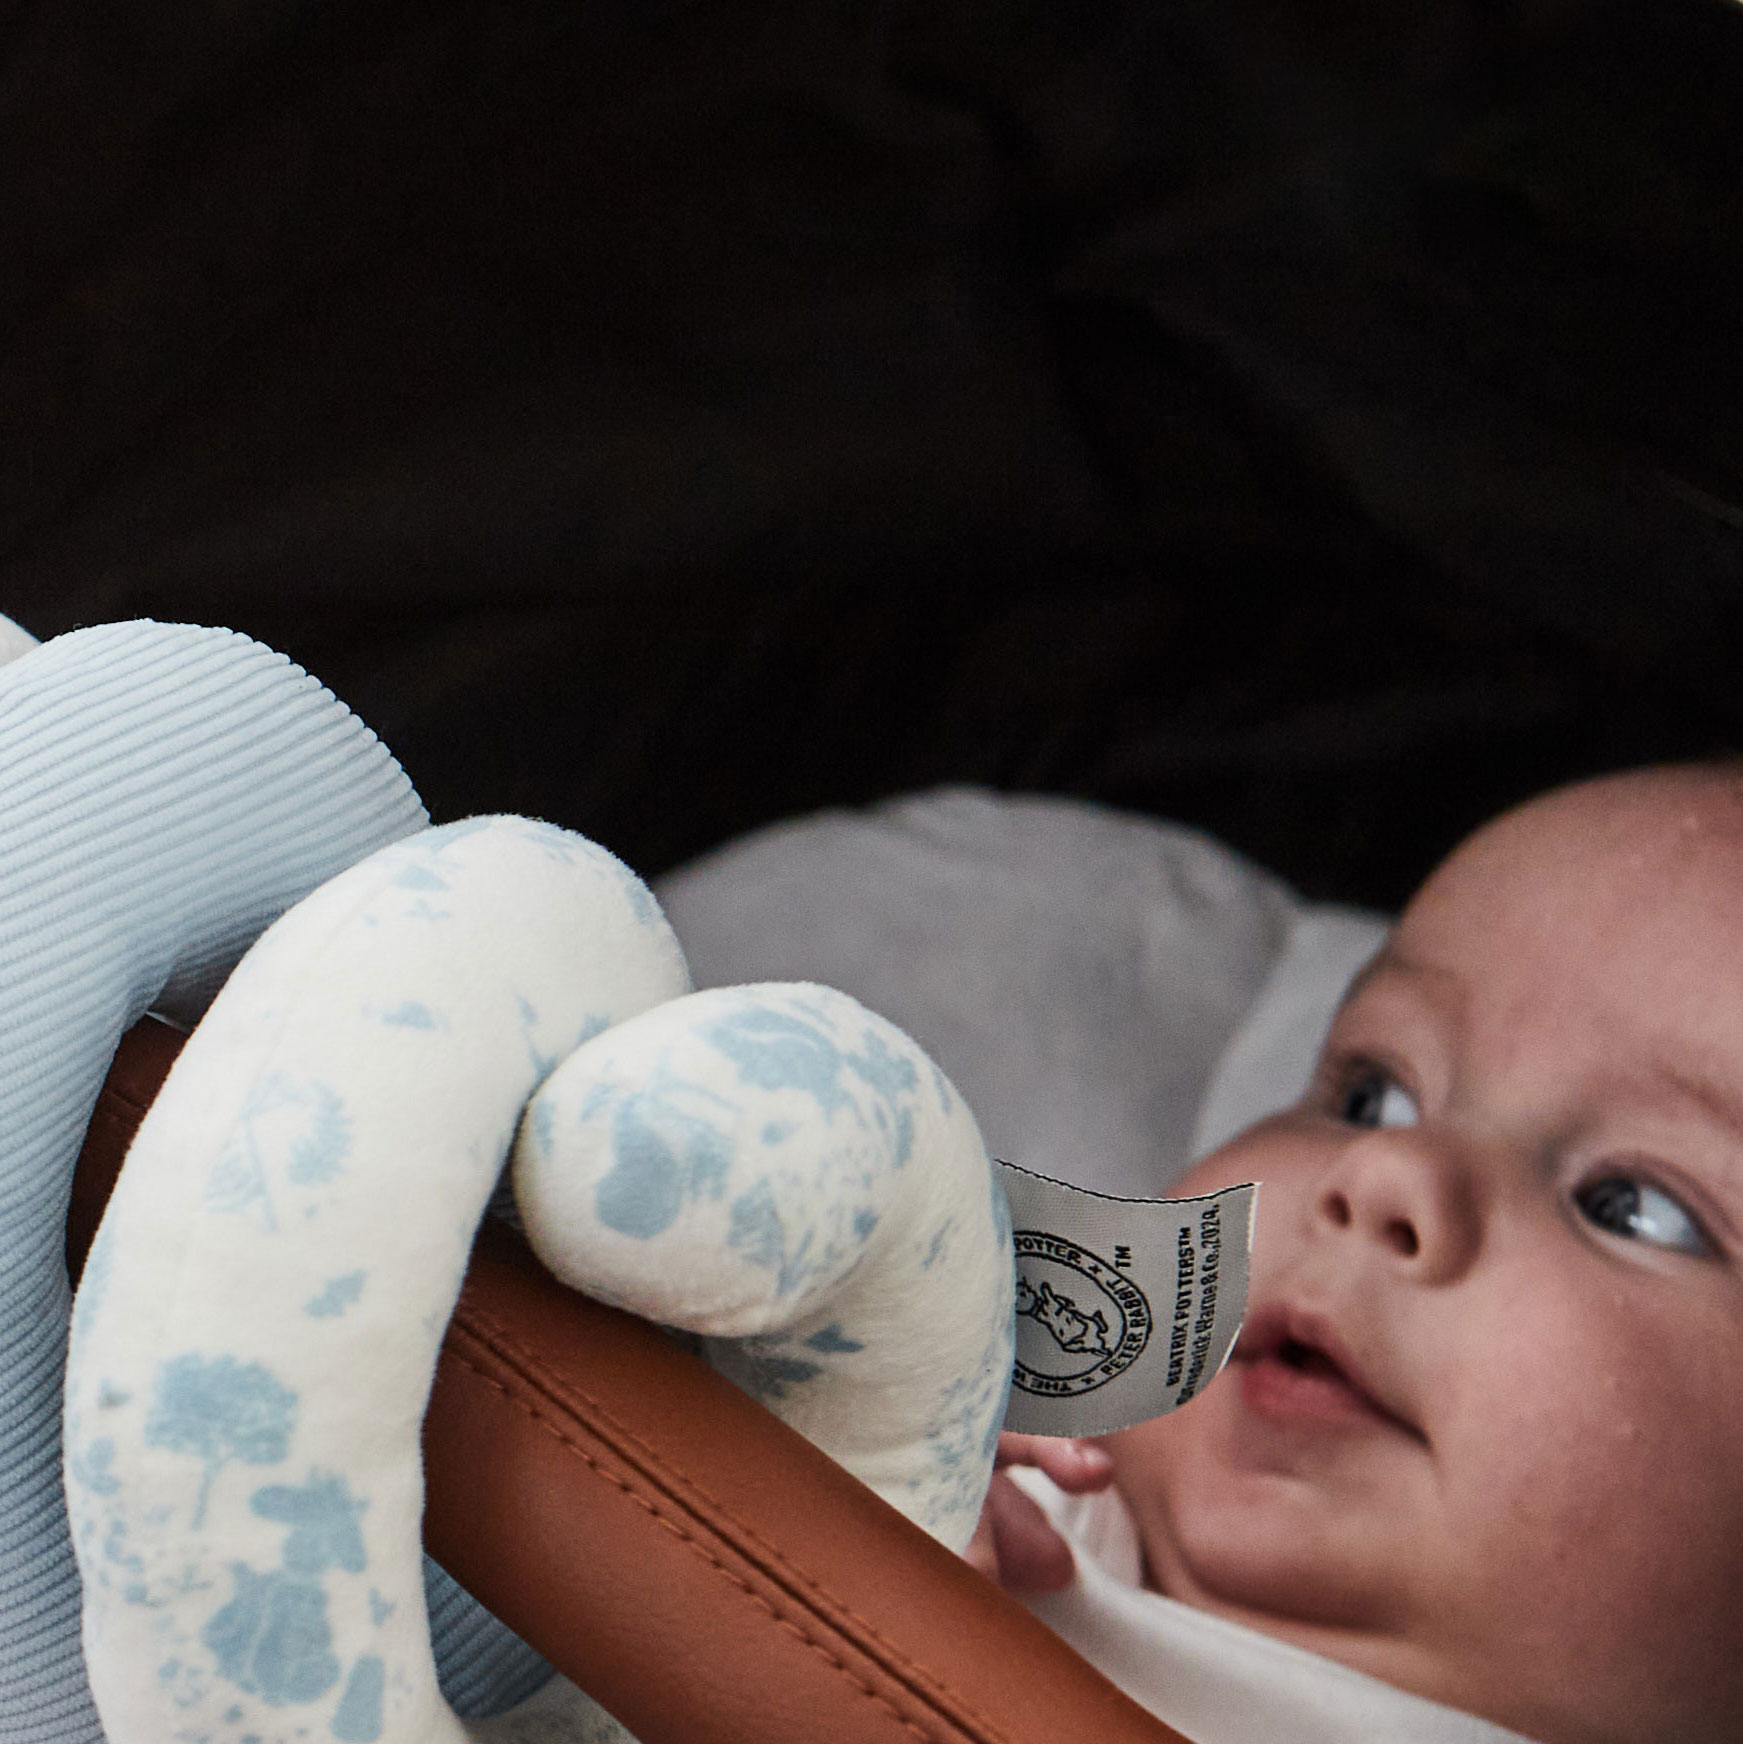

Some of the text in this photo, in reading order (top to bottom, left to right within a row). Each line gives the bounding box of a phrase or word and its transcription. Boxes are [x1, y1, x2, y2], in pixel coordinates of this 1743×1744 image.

[1100, 1279, 1147, 1375] PETER RABBIT
[1165, 1322, 1189, 1388] BEATRIX
[1030, 1377, 1072, 1393] THE
